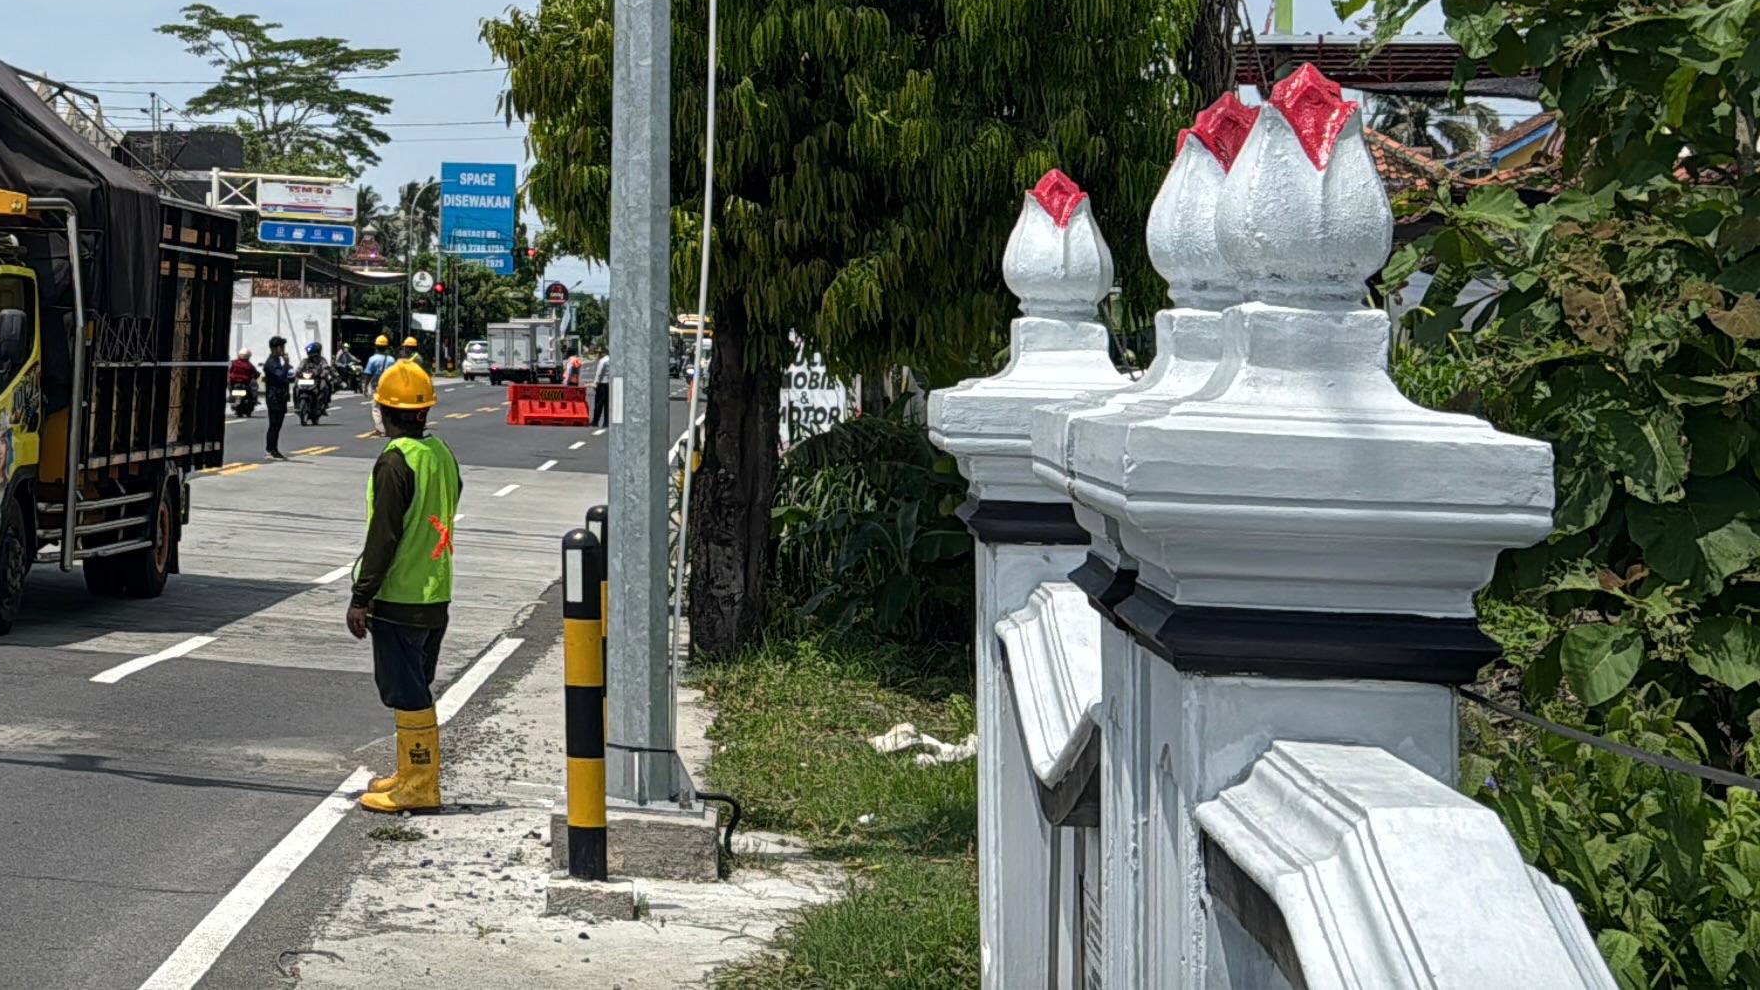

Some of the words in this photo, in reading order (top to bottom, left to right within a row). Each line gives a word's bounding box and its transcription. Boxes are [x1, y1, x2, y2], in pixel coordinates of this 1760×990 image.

[459, 172, 496, 186] SPACE
[443, 194, 511, 208] DISEWAKAN
[800, 391, 809, 404] &
